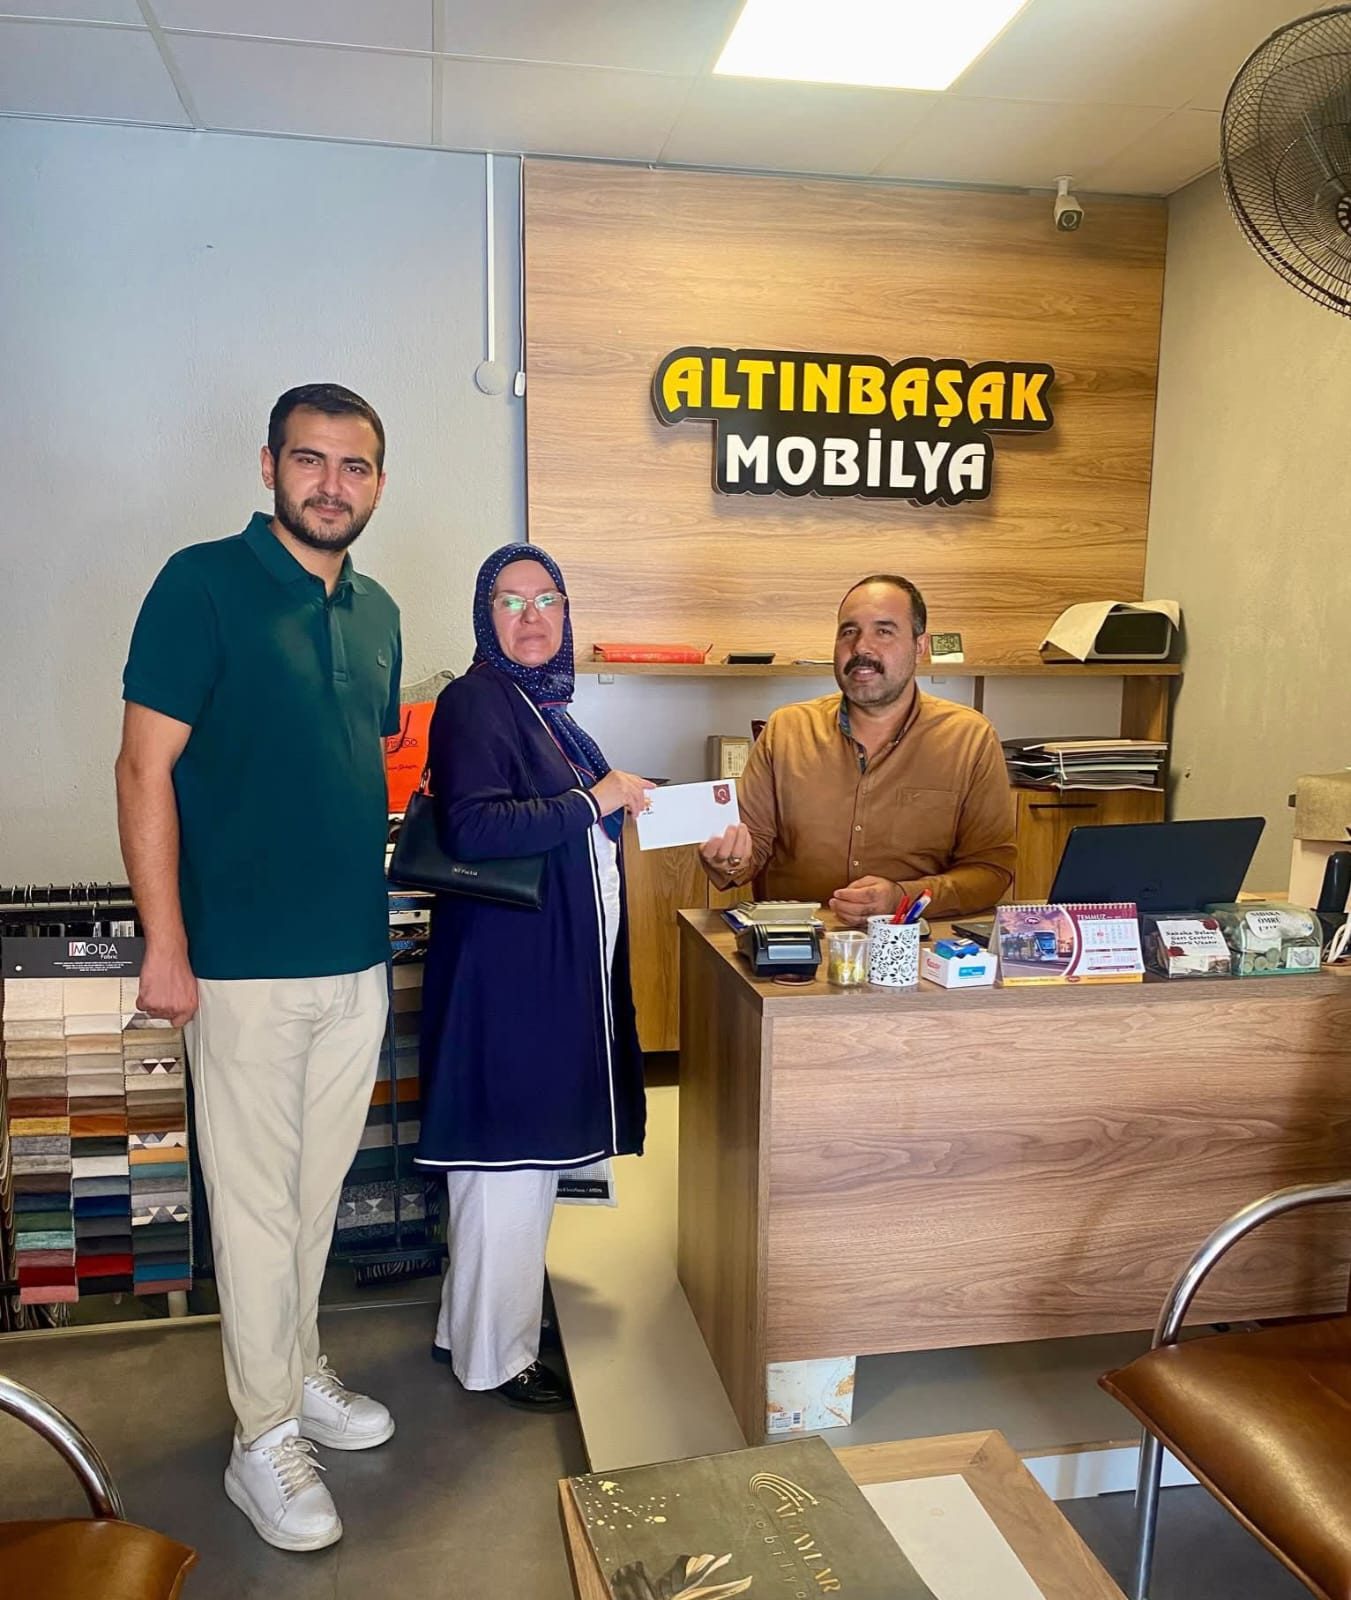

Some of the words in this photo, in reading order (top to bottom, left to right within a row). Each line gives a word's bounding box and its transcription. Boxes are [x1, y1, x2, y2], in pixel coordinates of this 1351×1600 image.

[663, 357, 1048, 427] ALTINBAŞAK
[726, 428, 986, 495] MOBİLYA
[69, 941, 118, 957] MODA
